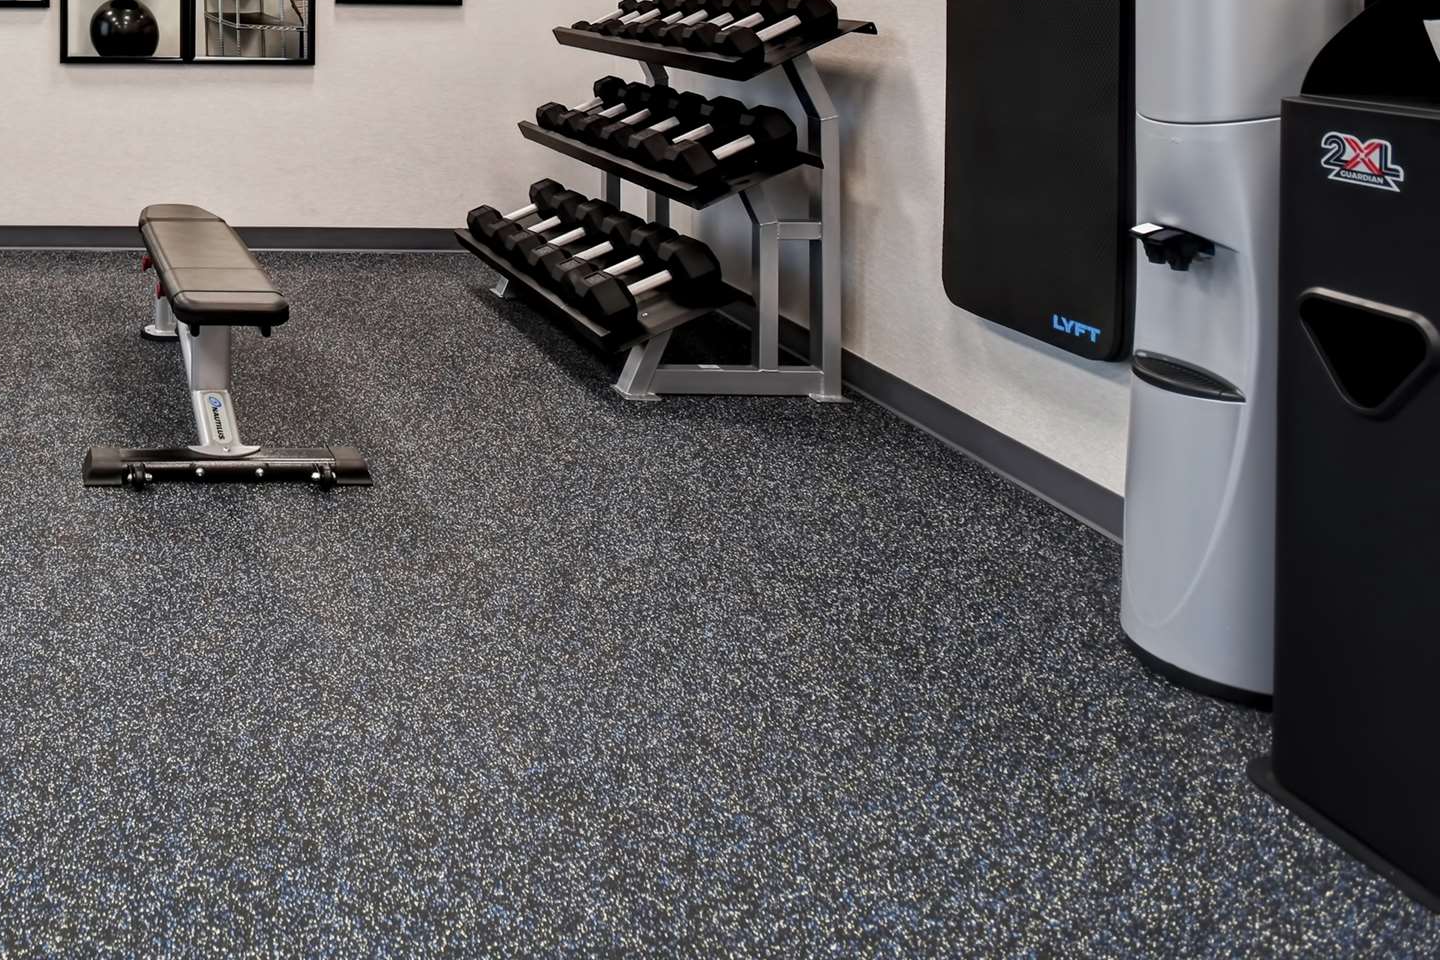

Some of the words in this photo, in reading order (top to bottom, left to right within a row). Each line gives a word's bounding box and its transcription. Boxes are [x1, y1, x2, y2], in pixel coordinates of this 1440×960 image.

[1321, 132, 1404, 181] 2XL
[1340, 170, 1384, 184] GUARDIAN
[1053, 314, 1101, 343] LYFT
[212, 406, 226, 440] NAUTILUS
